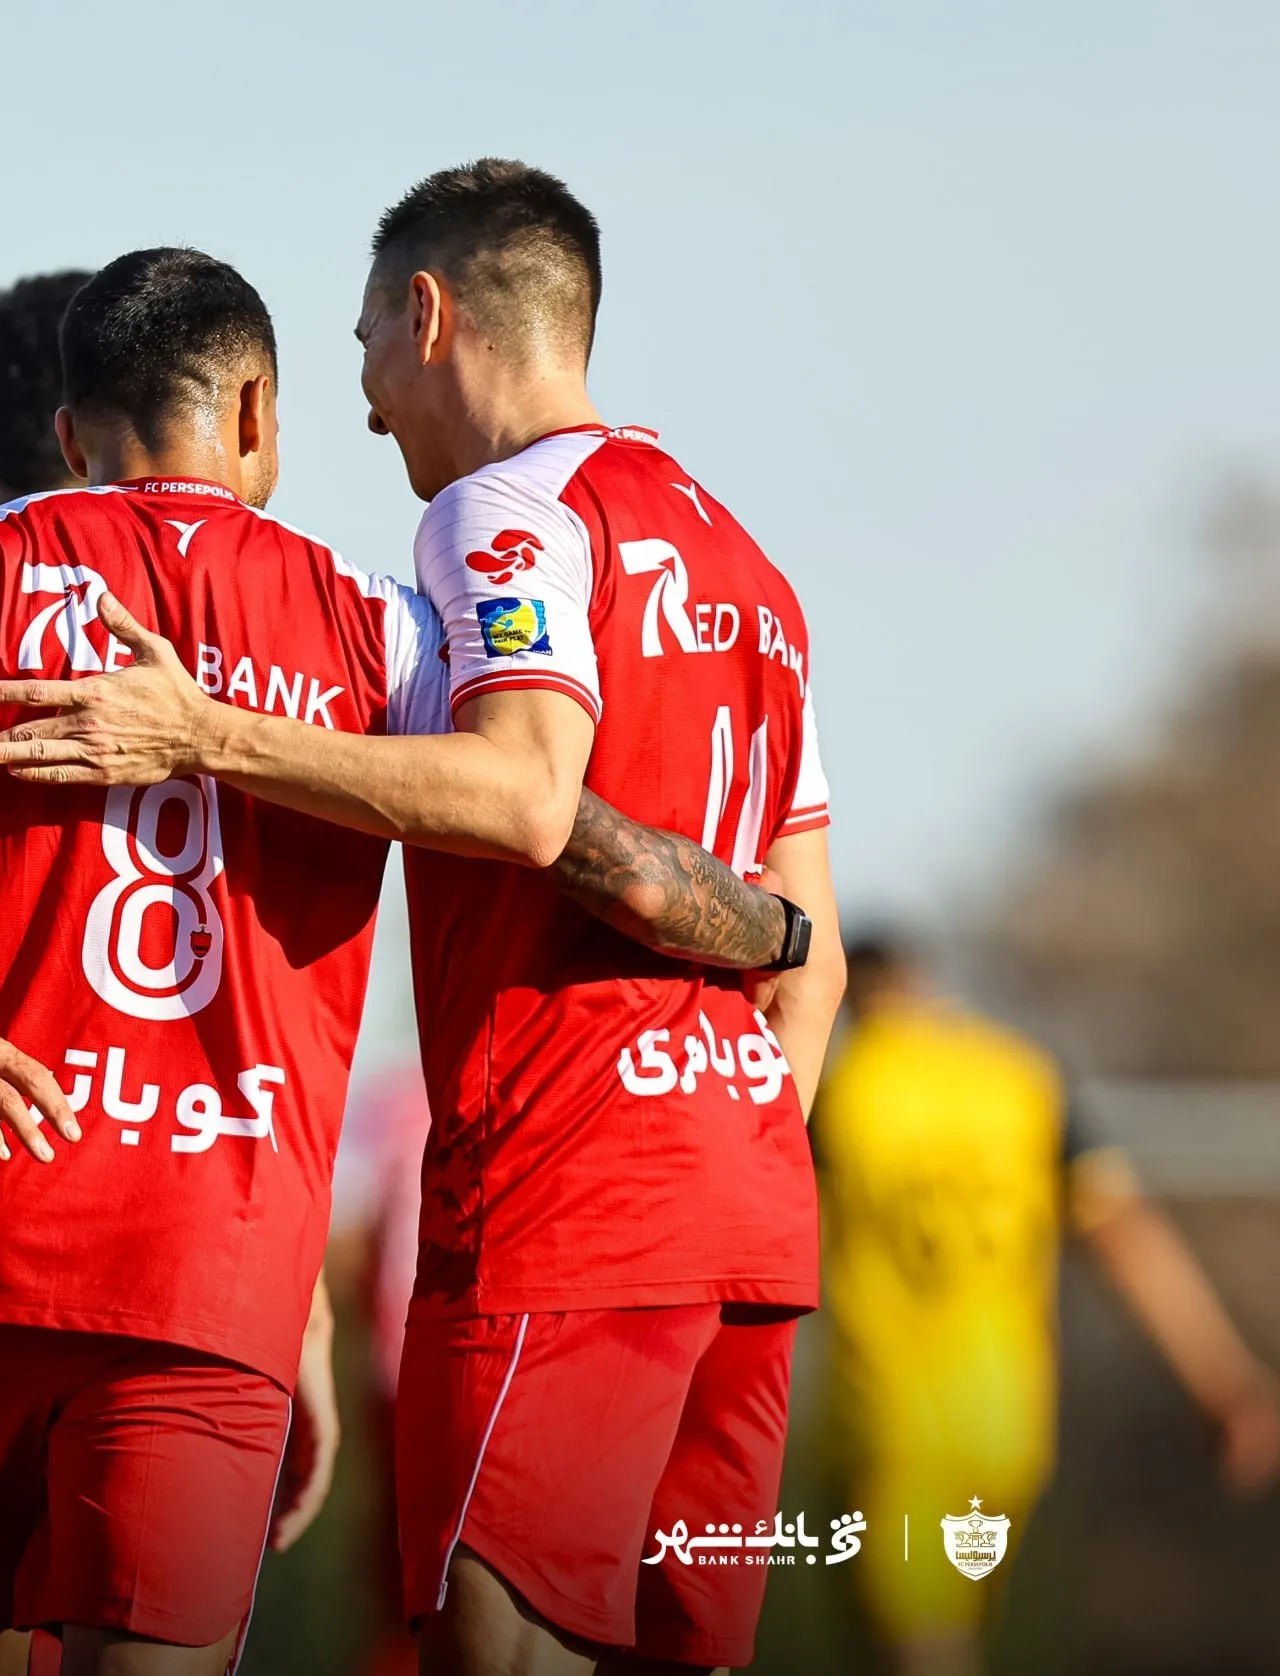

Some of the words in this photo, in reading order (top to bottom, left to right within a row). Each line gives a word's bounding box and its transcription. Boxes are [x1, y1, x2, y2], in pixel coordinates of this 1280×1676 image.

[144, 482, 159, 493] FC
[18, 562, 132, 672] RE
[195, 641, 345, 730] BANK
[81, 773, 225, 1021] 8
